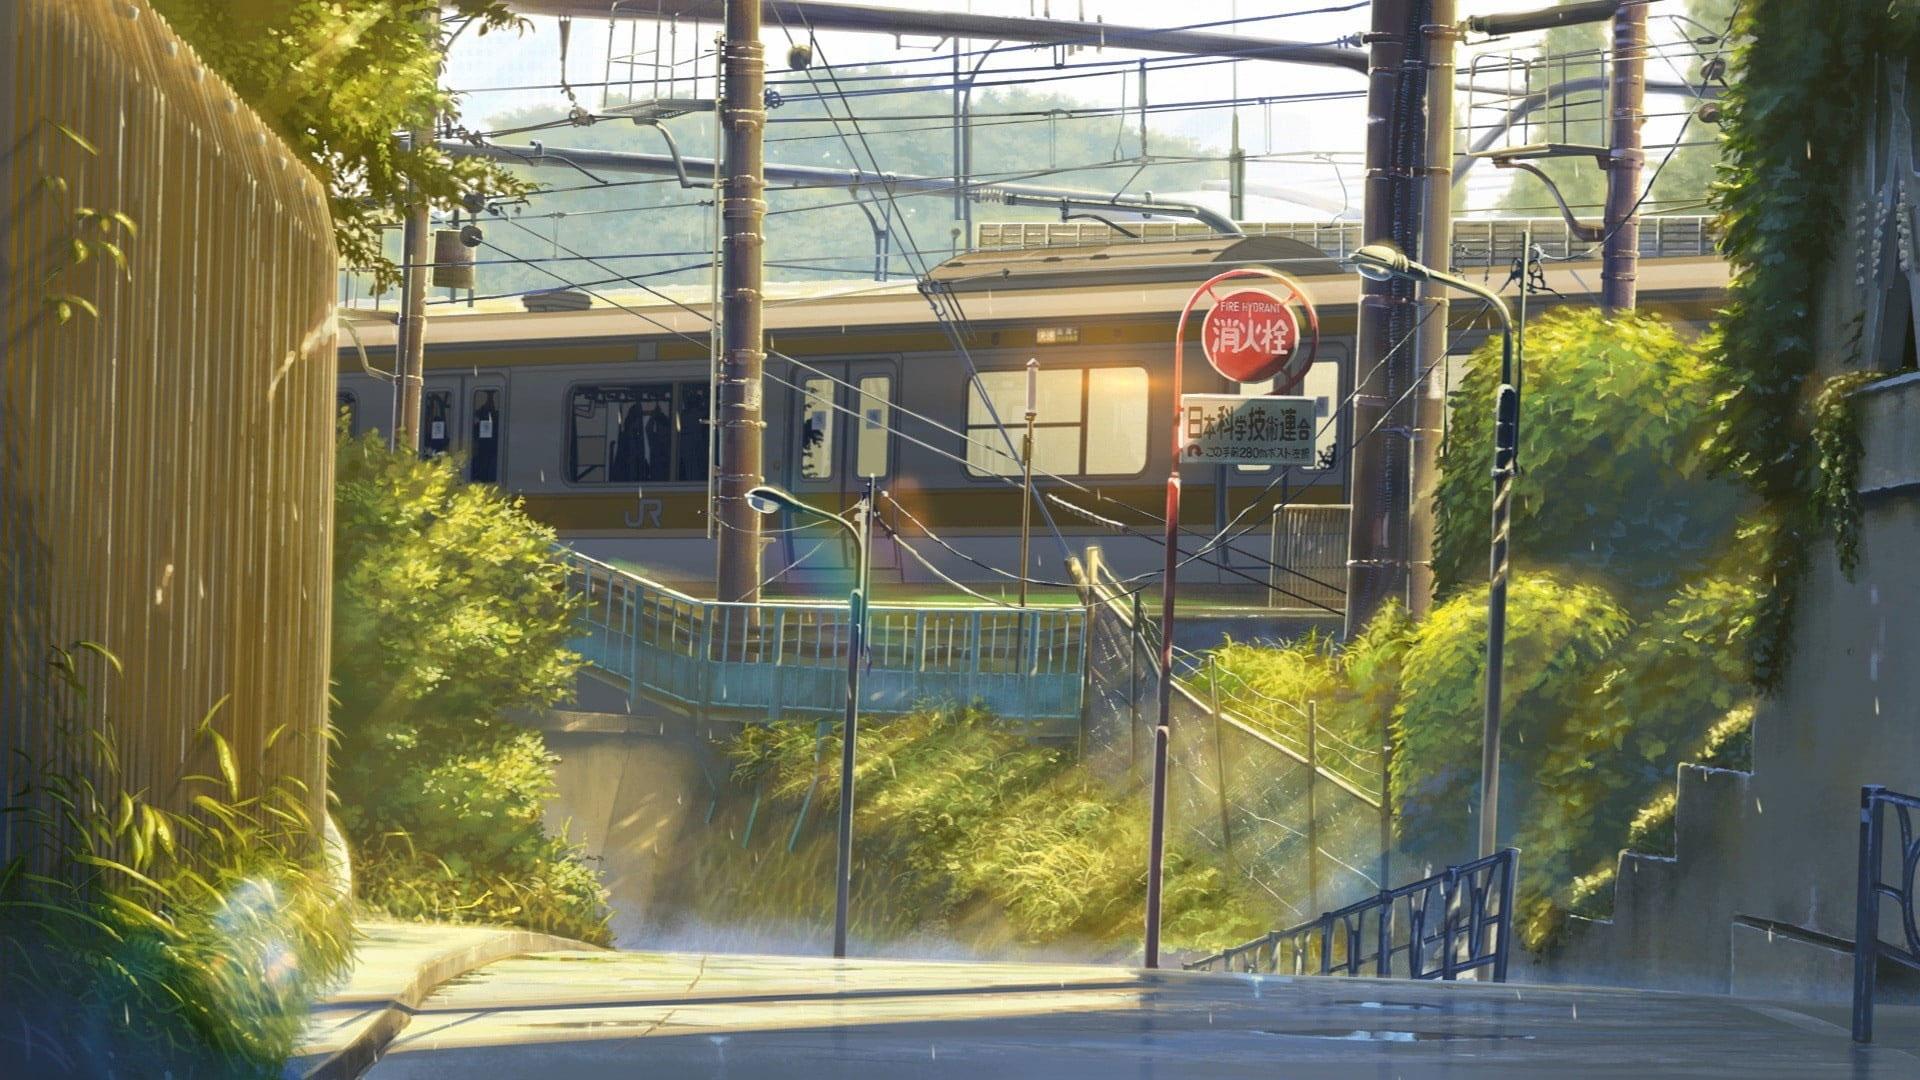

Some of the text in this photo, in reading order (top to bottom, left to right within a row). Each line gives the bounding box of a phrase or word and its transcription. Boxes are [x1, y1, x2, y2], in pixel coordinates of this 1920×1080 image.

[1220, 301, 1280, 313] FIRE HYDRANT
[1212, 318, 1289, 355] 消火栓
[1188, 405, 1312, 441] 日本科学技術連合
[624, 499, 663, 529] JR
